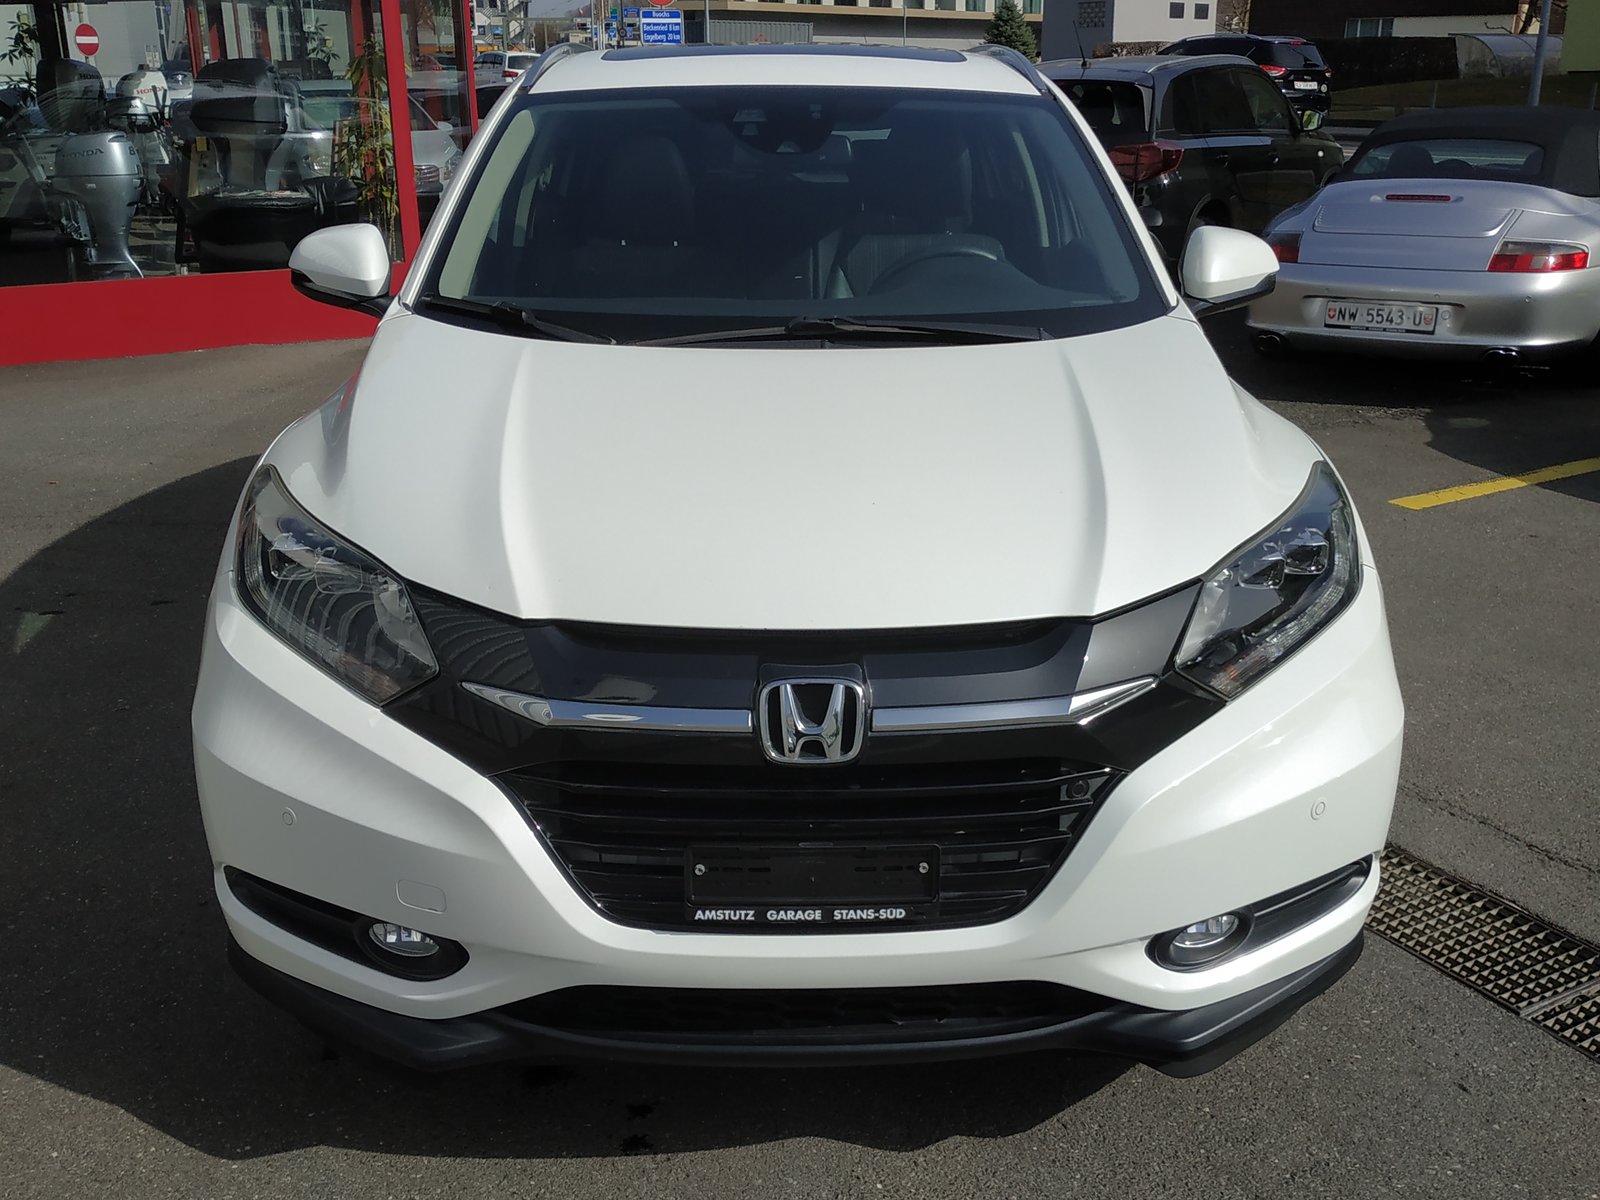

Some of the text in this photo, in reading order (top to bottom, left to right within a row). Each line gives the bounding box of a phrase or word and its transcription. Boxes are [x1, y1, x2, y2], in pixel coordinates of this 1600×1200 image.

[652, 10, 670, 18] Buochs
[643, 23, 668, 31] Beckenried
[673, 23, 680, 31] km
[643, 32, 667, 42] Engelberg
[1337, 306, 1423, 327] NW 5543 U
[694, 908, 906, 921] AMSTUTZ GARAGE STANS-SÜD
